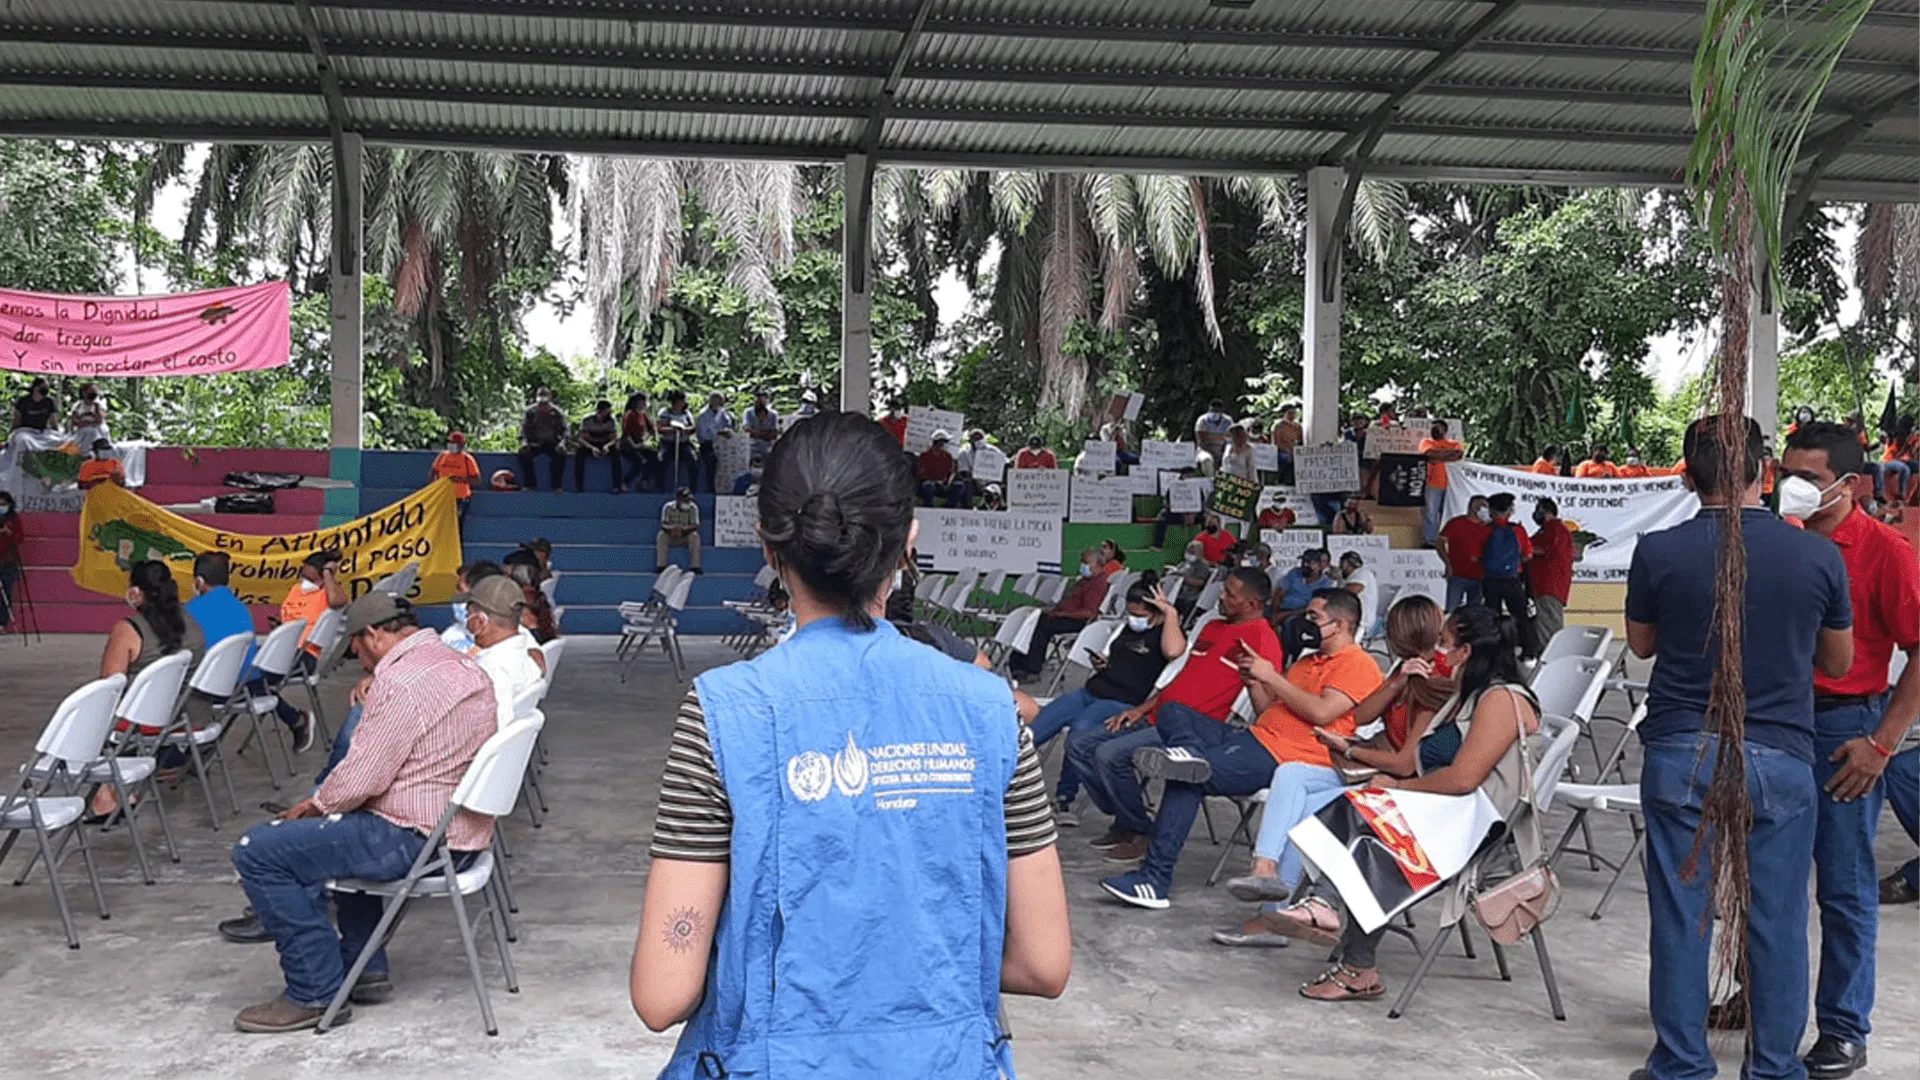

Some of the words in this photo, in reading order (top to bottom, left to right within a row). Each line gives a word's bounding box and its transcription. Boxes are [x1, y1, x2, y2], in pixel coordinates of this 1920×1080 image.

[55, 301, 70, 320] la
[84, 301, 160, 326] Dignidad
[13, 323, 43, 344] dar
[57, 327, 113, 351] tregua
[13, 350, 28, 368] Y
[41, 355, 65, 372] sin
[76, 354, 151, 375] importar
[163, 351, 179, 369] el
[187, 348, 238, 368] costo
[1517, 477, 1547, 490] DIGNO
[1610, 483, 1625, 493] NO
[1627, 483, 1639, 495] SE
[1564, 496, 1577, 508] SE
[215, 533, 245, 551] En
[229, 557, 304, 580] rohibi
[338, 556, 357, 575] el
[1603, 568, 1629, 580] SIEM
[867, 743, 925, 758] NACIONES
[927, 743, 968, 756] UNIDAS
[870, 759, 921, 773] DERECHOS
[923, 758, 976, 771] HUMANOS
